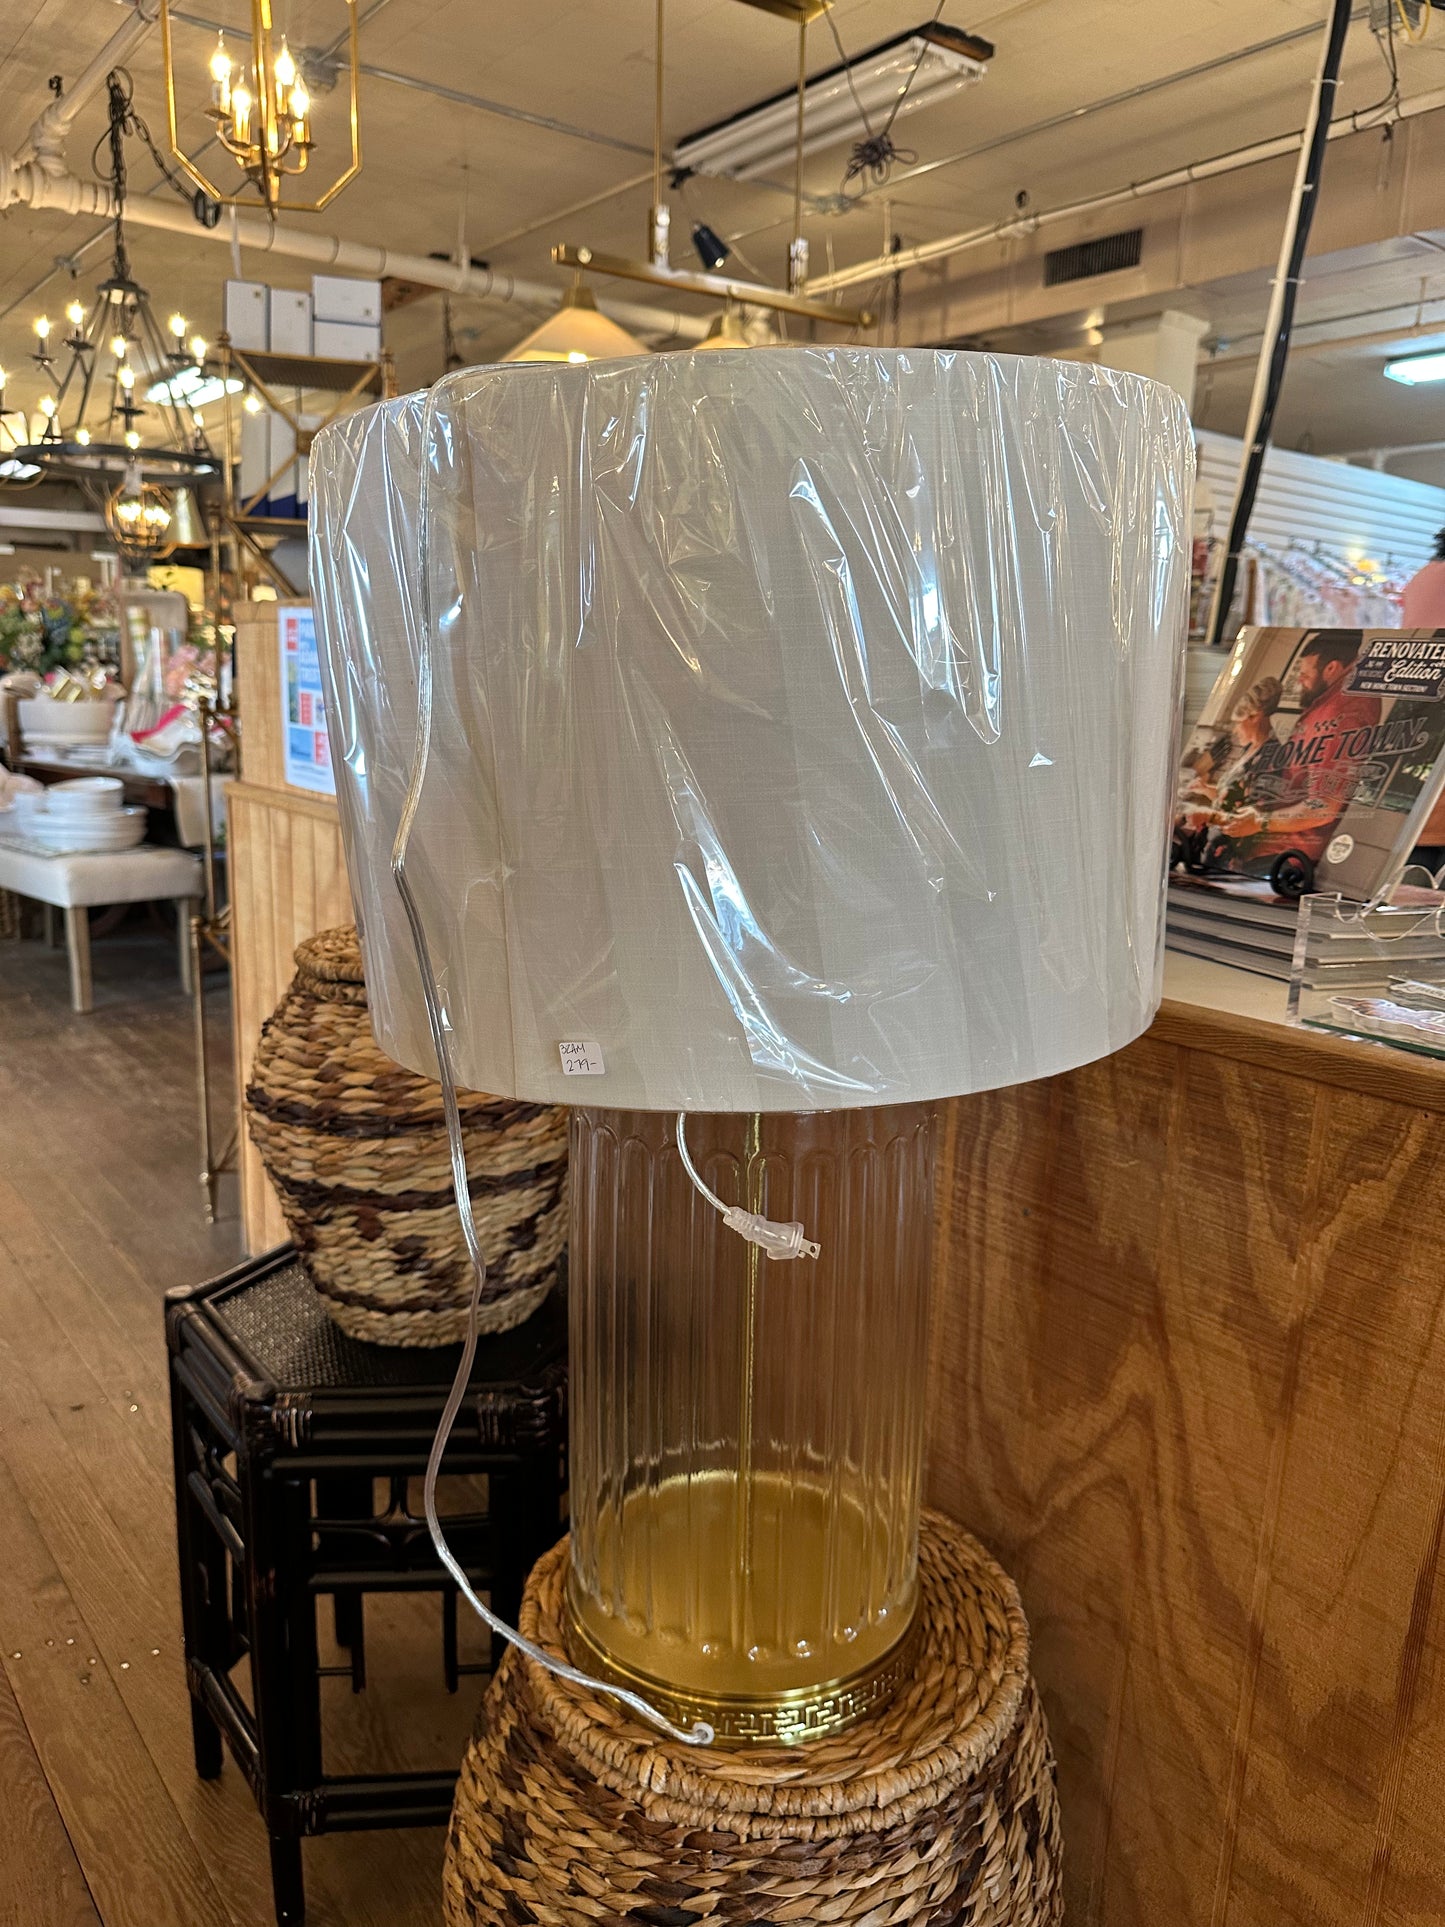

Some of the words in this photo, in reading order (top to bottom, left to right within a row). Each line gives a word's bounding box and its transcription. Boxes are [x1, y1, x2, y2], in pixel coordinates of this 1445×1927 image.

[1383, 659, 1442, 682] Edition
[1257, 733, 1335, 771] HOME
[1332, 717, 1428, 760] TOWN
